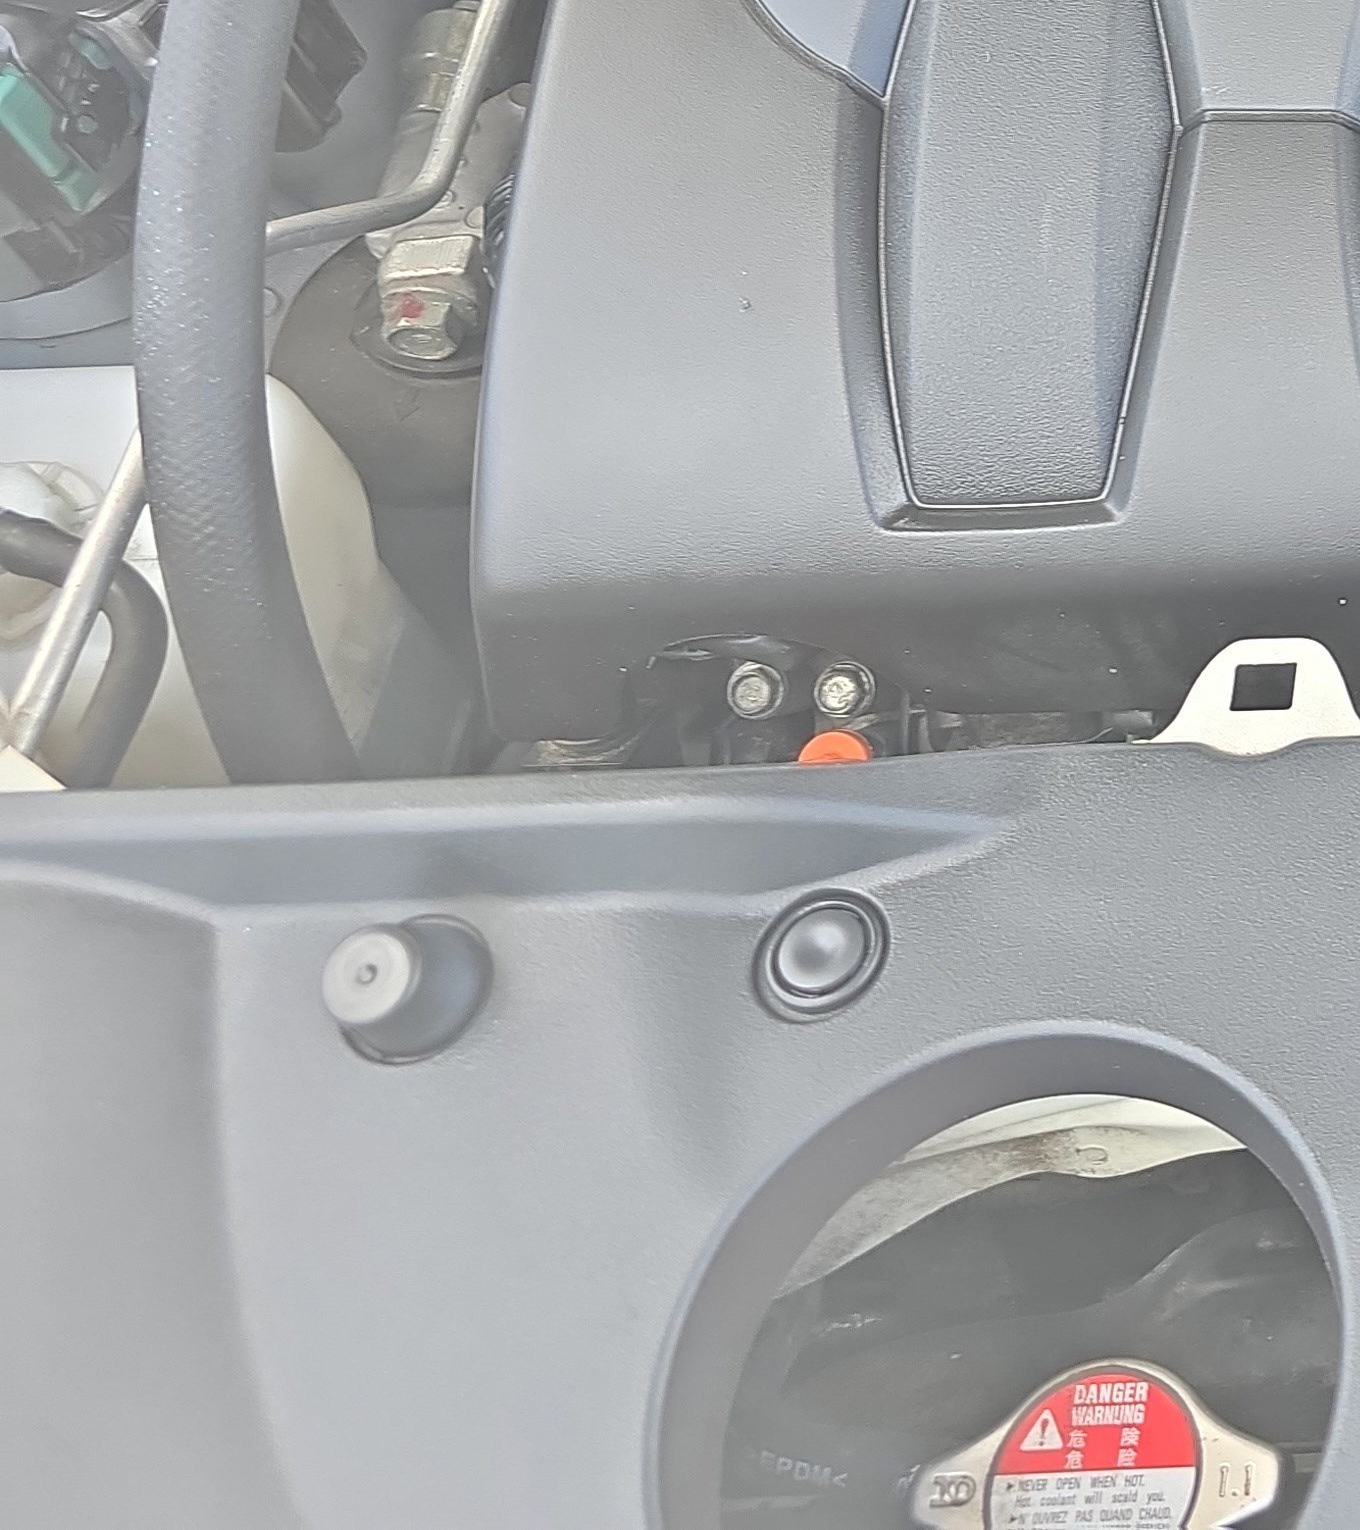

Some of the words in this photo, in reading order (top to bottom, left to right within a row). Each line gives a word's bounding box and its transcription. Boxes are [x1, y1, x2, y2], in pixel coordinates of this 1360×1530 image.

[1073, 1381, 1149, 1405] DANGER
[1017, 1478, 1048, 1492] NEVER
[1055, 1476, 1081, 1490] OPEN
[1090, 1475, 1117, 1489] WHEN
[1039, 1492, 1077, 1507] coolant
[1084, 1491, 1103, 1505] will
[1111, 1490, 1138, 1504] scald
[1074, 1509, 1094, 1523] PAS
[1100, 1508, 1133, 1522] QUAND
